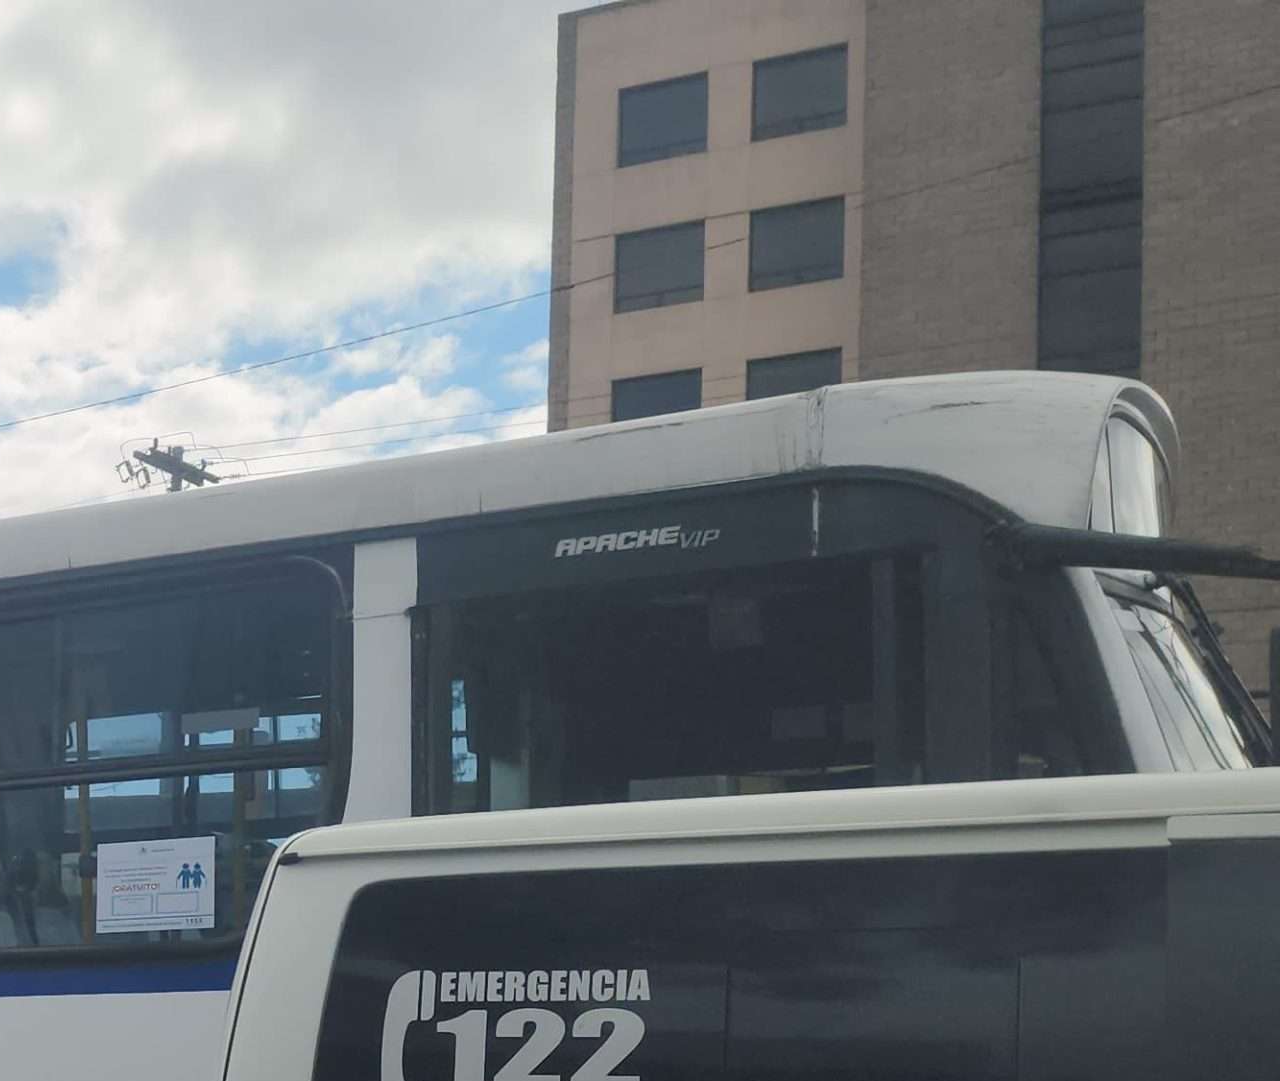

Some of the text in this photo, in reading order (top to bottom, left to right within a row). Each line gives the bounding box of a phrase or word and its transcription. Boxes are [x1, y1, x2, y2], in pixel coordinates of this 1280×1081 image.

[554, 525, 721, 558] APACHE VIP
[440, 969, 651, 1002] EMERGENCIA
